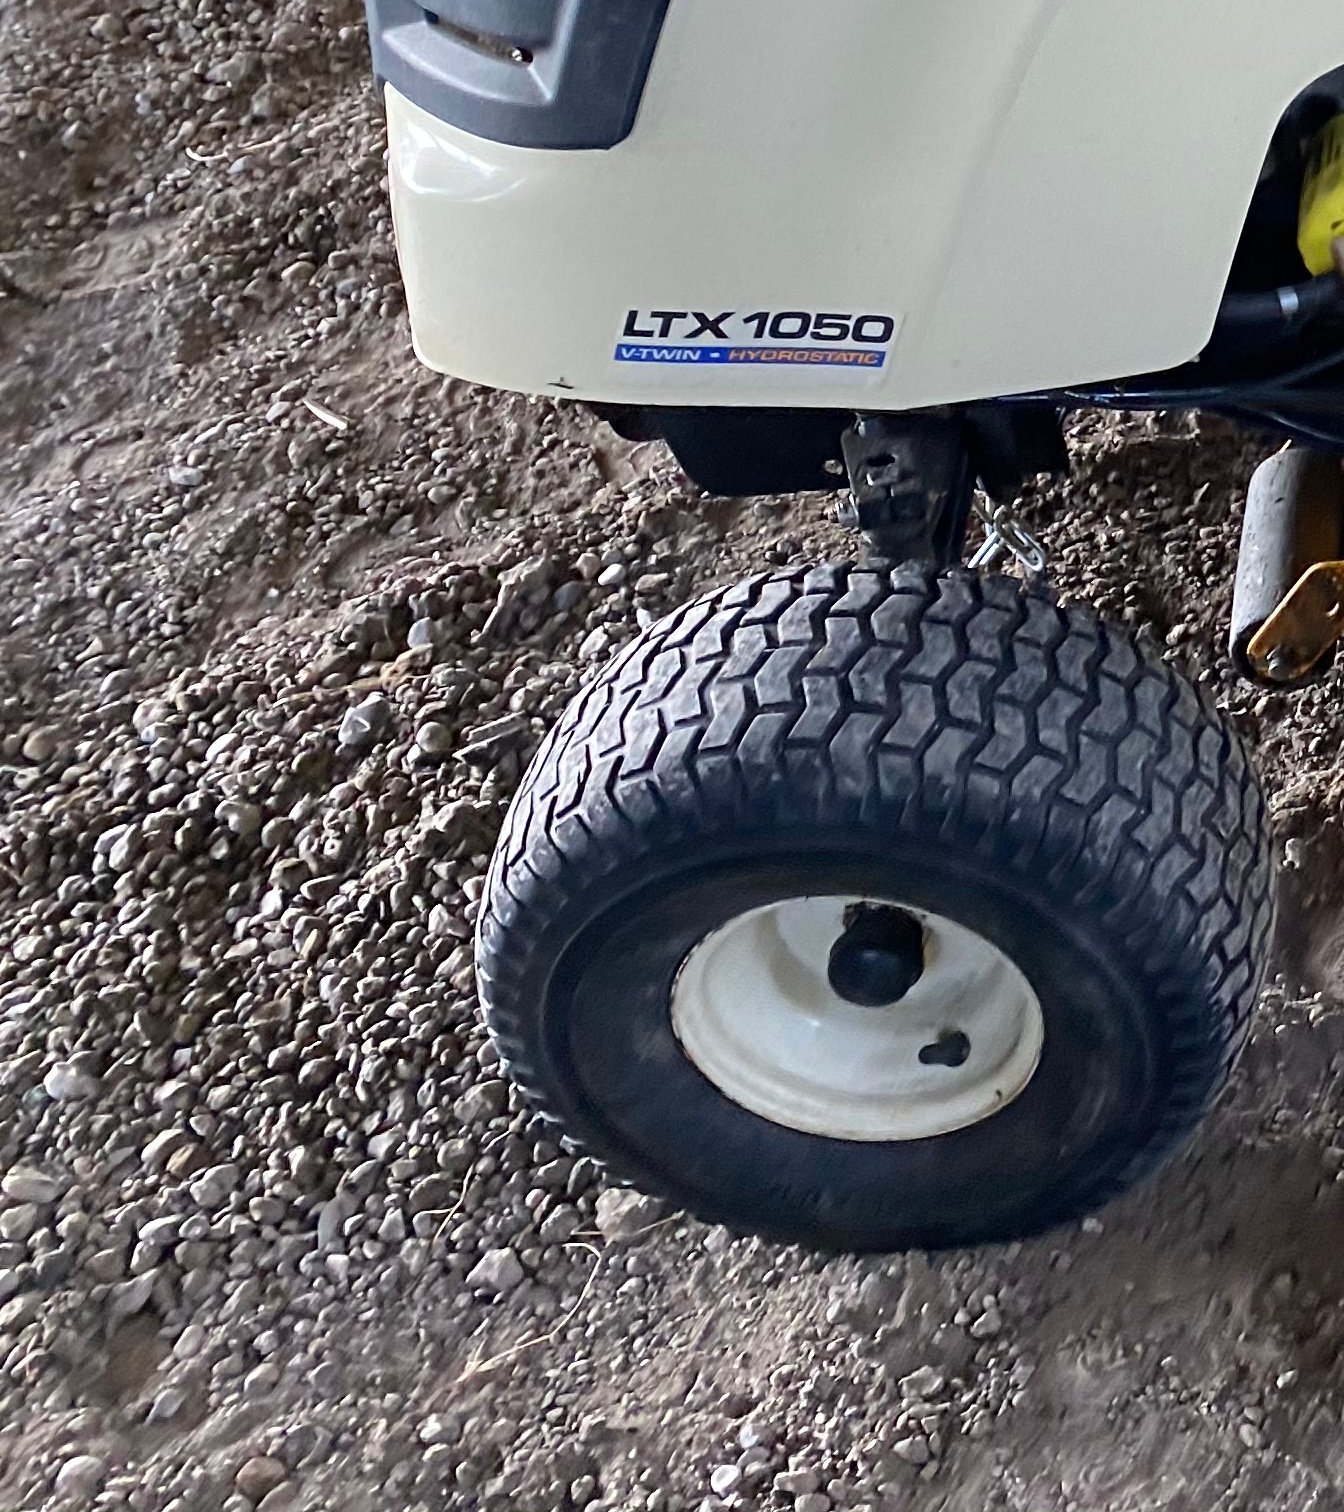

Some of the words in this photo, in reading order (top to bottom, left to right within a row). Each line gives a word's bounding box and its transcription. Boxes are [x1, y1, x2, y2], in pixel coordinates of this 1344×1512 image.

[622, 309, 737, 339] LTX
[742, 311, 895, 344] 1050
[620, 346, 701, 361] V-TWIN
[728, 349, 881, 365] HYDROSTATIC
